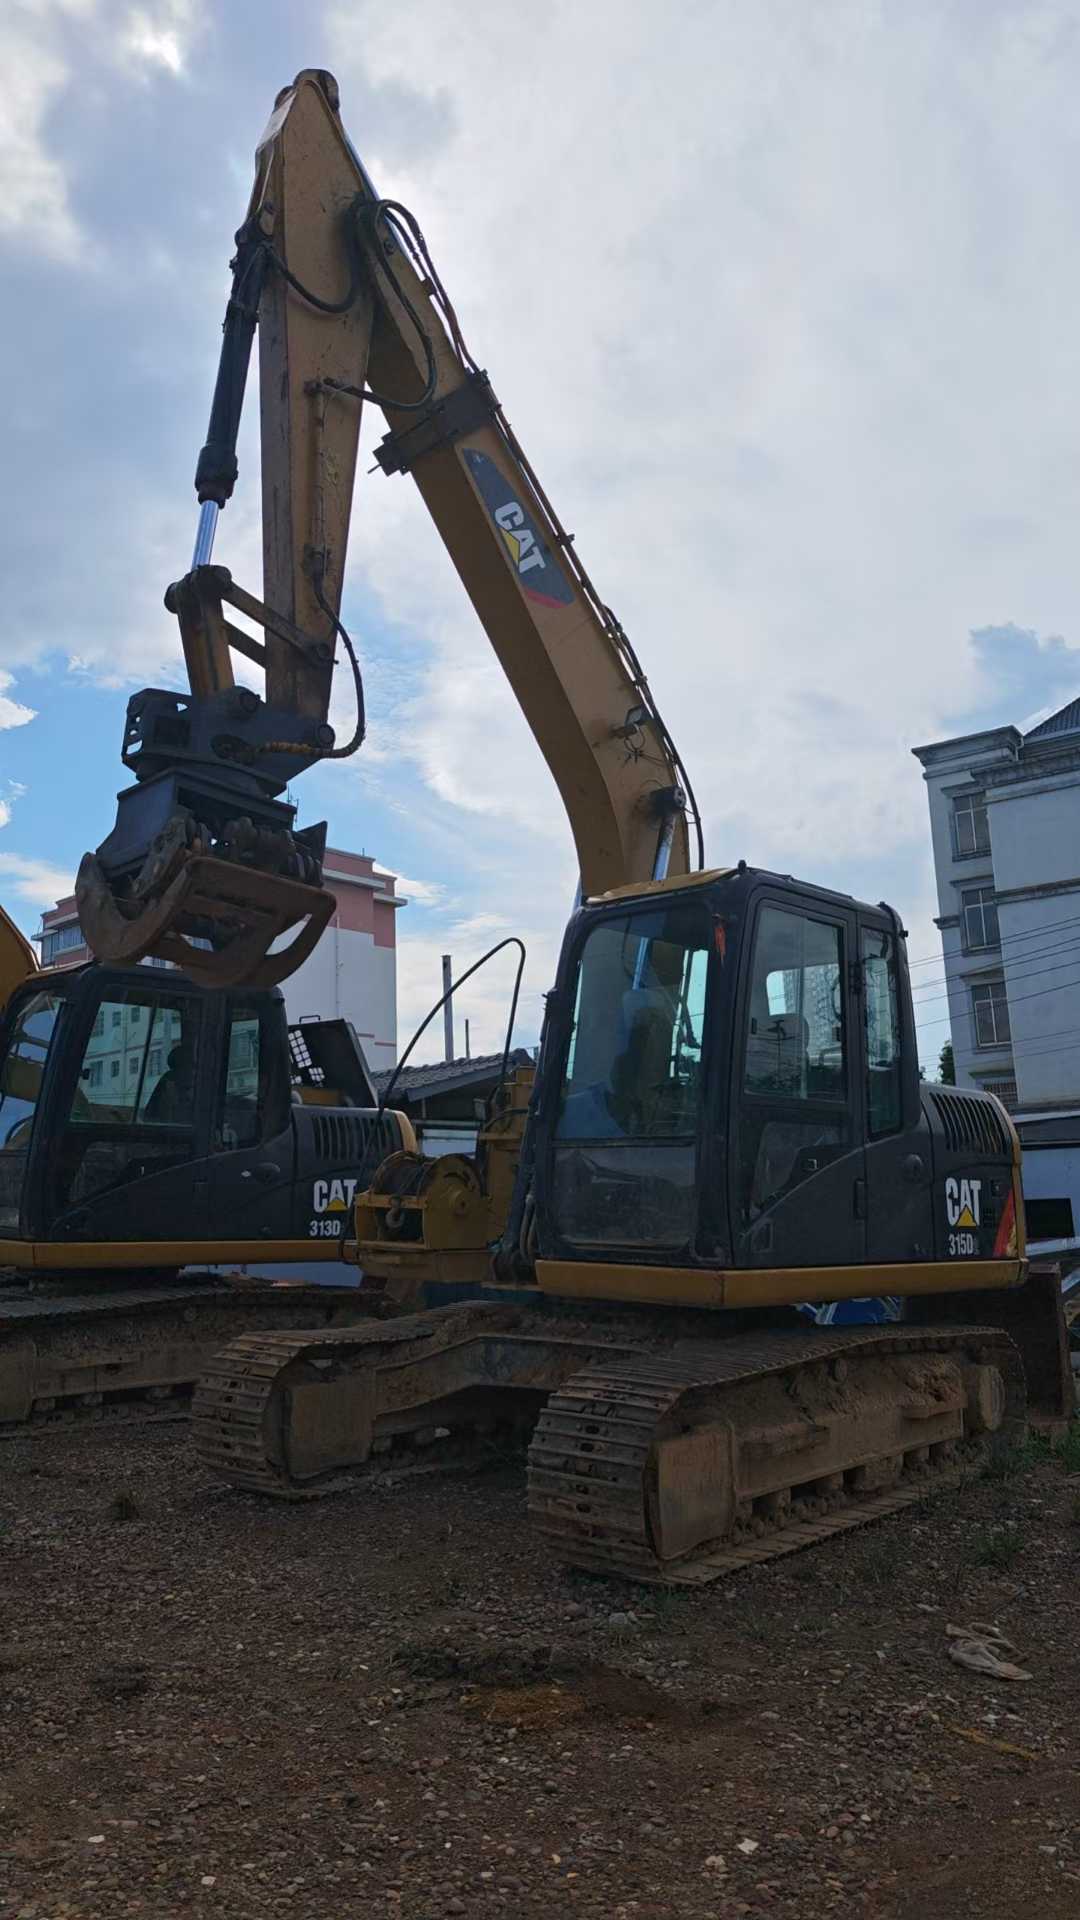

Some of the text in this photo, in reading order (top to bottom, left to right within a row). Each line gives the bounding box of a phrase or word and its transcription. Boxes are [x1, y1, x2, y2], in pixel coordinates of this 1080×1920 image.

[495, 502, 546, 573] CAT
[313, 1179, 357, 1212] CAT
[945, 1177, 981, 1227] CAT
[309, 1220, 341, 1236] 313D
